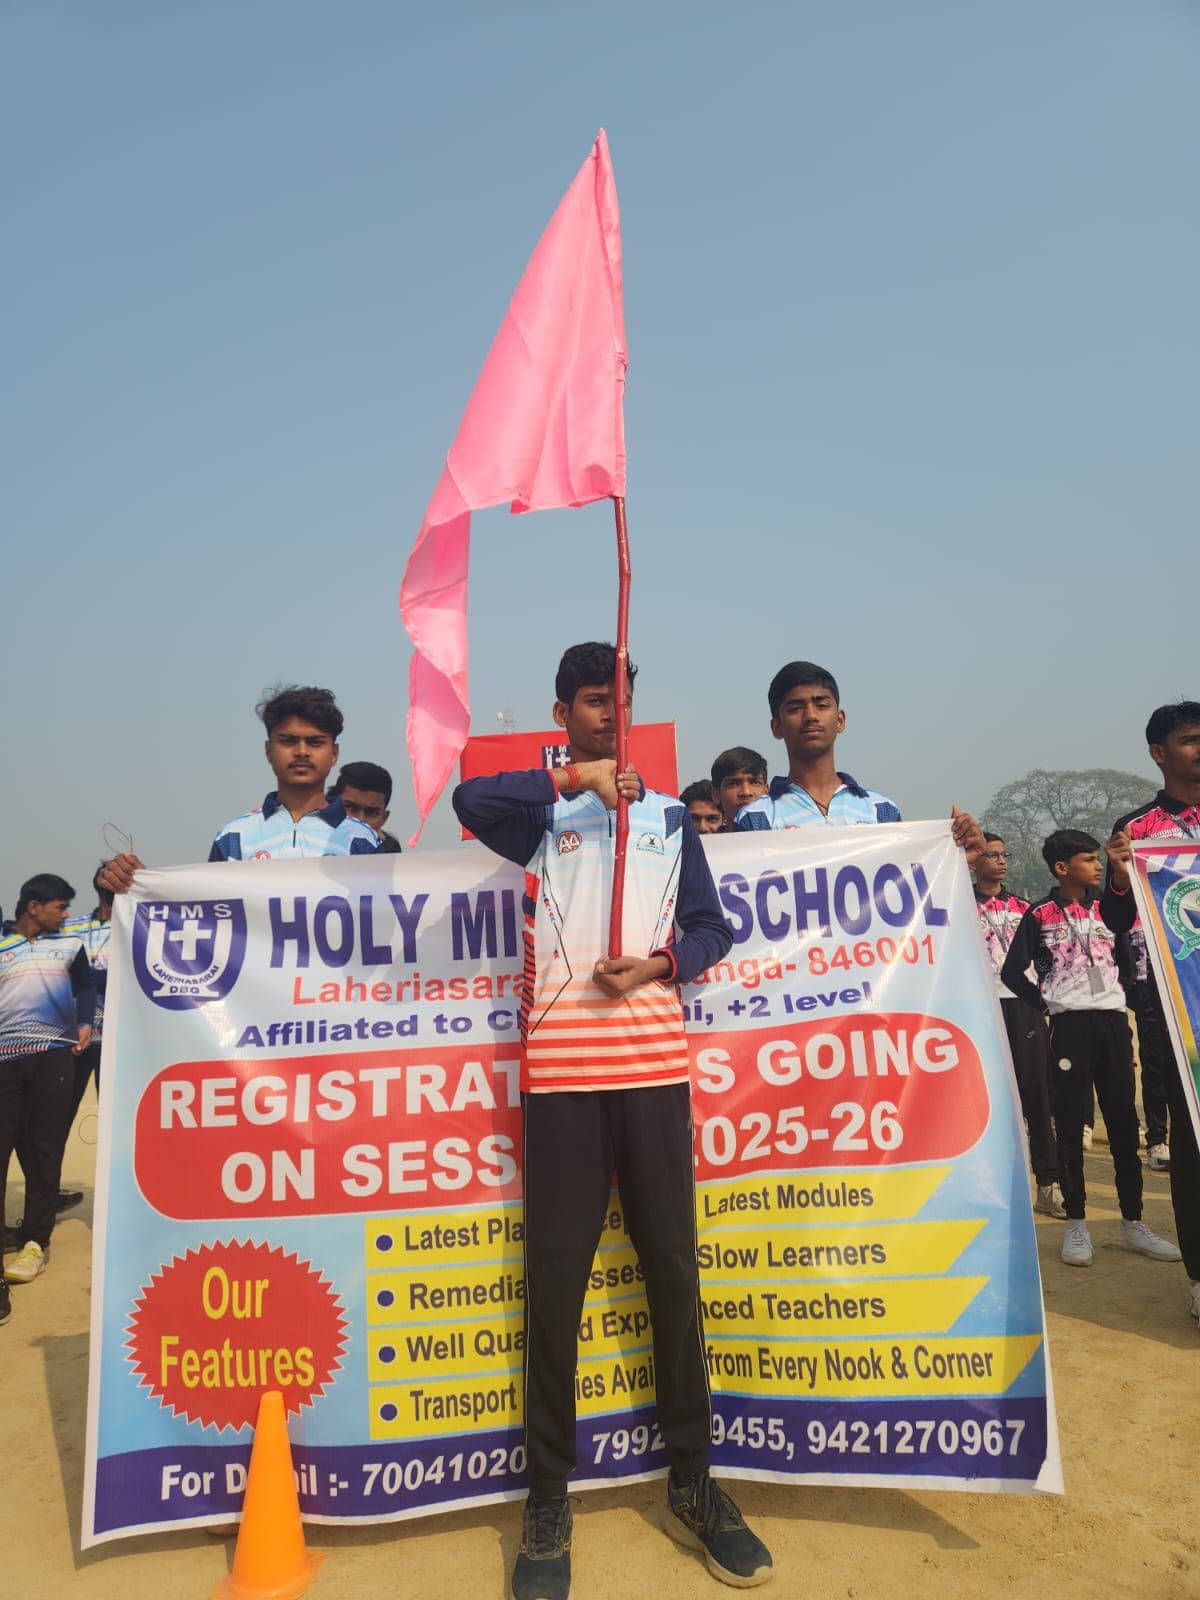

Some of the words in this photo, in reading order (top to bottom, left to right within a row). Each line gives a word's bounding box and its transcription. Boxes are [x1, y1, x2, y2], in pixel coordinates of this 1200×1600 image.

[269, 893, 430, 969] HOLY
[451, 889, 527, 961] MI
[719, 863, 951, 944] SCHOOL
[293, 972, 526, 1006] Laheriasara
[808, 934, 935, 976] 846001
[235, 1013, 419, 1048] Affiliated
[433, 1014, 473, 1033] to
[727, 995, 771, 1018] +2
[783, 981, 873, 1014] level
[160, 1060, 522, 1129] REGISTRAT
[696, 1047, 736, 1094] S
[756, 1028, 960, 1087] GOING
[221, 1149, 316, 1203] ON
[341, 1134, 517, 1197] SESS
[694, 1101, 904, 1167] 025-26
[405, 1219, 479, 1251] Latest
[487, 1216, 525, 1247] Pla
[704, 1186, 770, 1217] Latest
[777, 1182, 875, 1211] Modules
[202, 1266, 269, 1320] Our
[409, 1275, 526, 1310] Remedia
[697, 1242, 759, 1270] Slow
[767, 1240, 887, 1268] Learners
[160, 1335, 315, 1388] Features
[406, 1333, 465, 1362] Well
[761, 1292, 886, 1320] Teachers
[410, 1382, 517, 1423] Transport
[707, 1345, 753, 1379] from
[759, 1347, 817, 1389] Every
[825, 1345, 885, 1382] Nook
[891, 1345, 908, 1379] &
[913, 1345, 994, 1378] Corner
[161, 1465, 214, 1500] For
[362, 1446, 527, 1496] 70041020
[807, 1419, 1026, 1456] 9421270967
